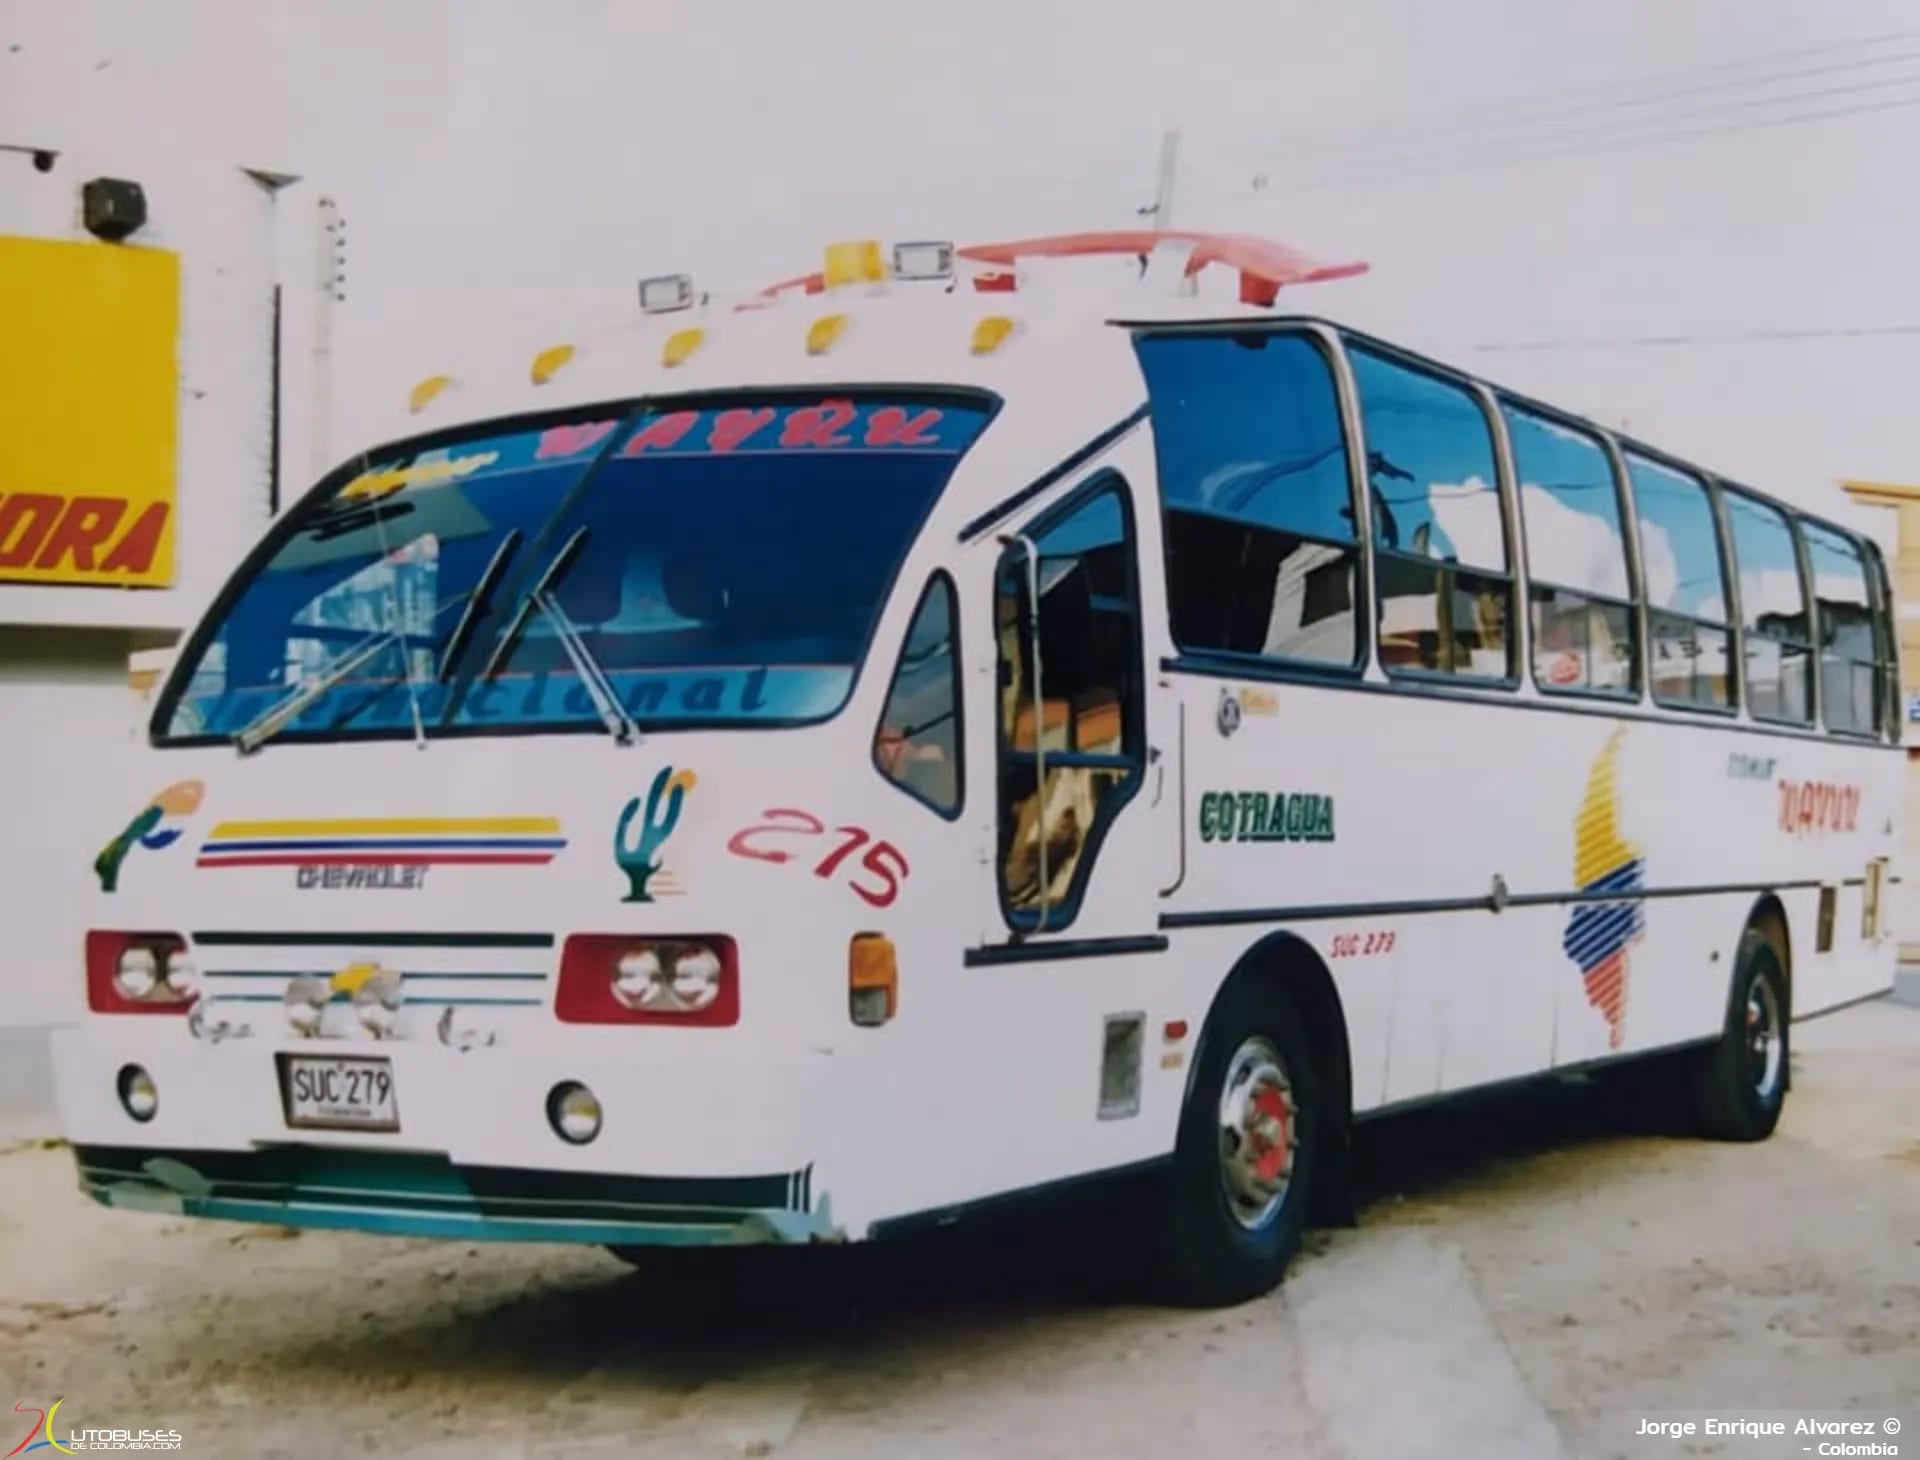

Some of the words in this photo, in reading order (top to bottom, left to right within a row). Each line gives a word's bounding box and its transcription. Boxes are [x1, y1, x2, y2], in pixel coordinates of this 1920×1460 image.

[1200, 790, 1336, 843] COTRAGUA
[296, 863, 431, 890] CHEVROLET
[727, 808, 909, 908] 275
[295, 1067, 340, 1103] SUC
[345, 1069, 391, 1106] 279
